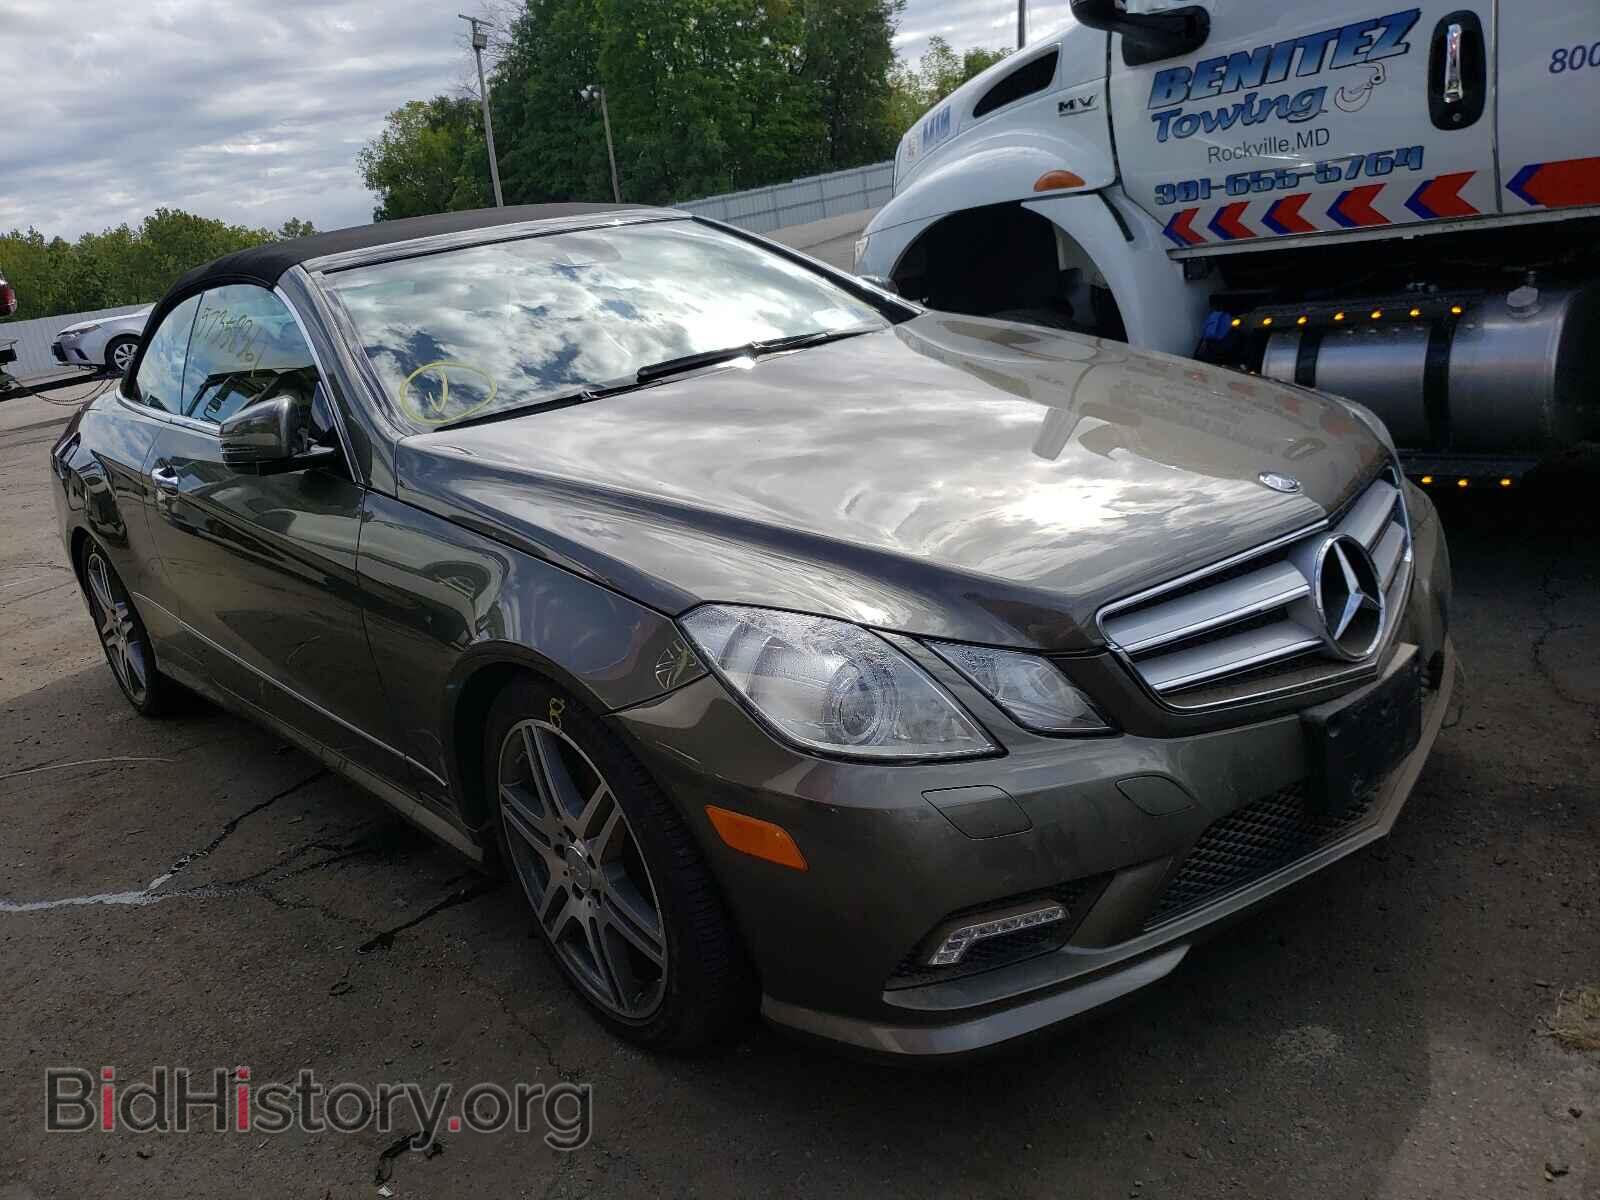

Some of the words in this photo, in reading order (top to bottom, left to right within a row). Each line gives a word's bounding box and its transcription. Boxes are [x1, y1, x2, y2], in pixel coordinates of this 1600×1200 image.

[1148, 8, 1422, 110] BENITEZ
[1058, 95, 1094, 113] MV
[1151, 86, 1328, 143] Towing
[1154, 145, 1424, 205] 301-655-5764
